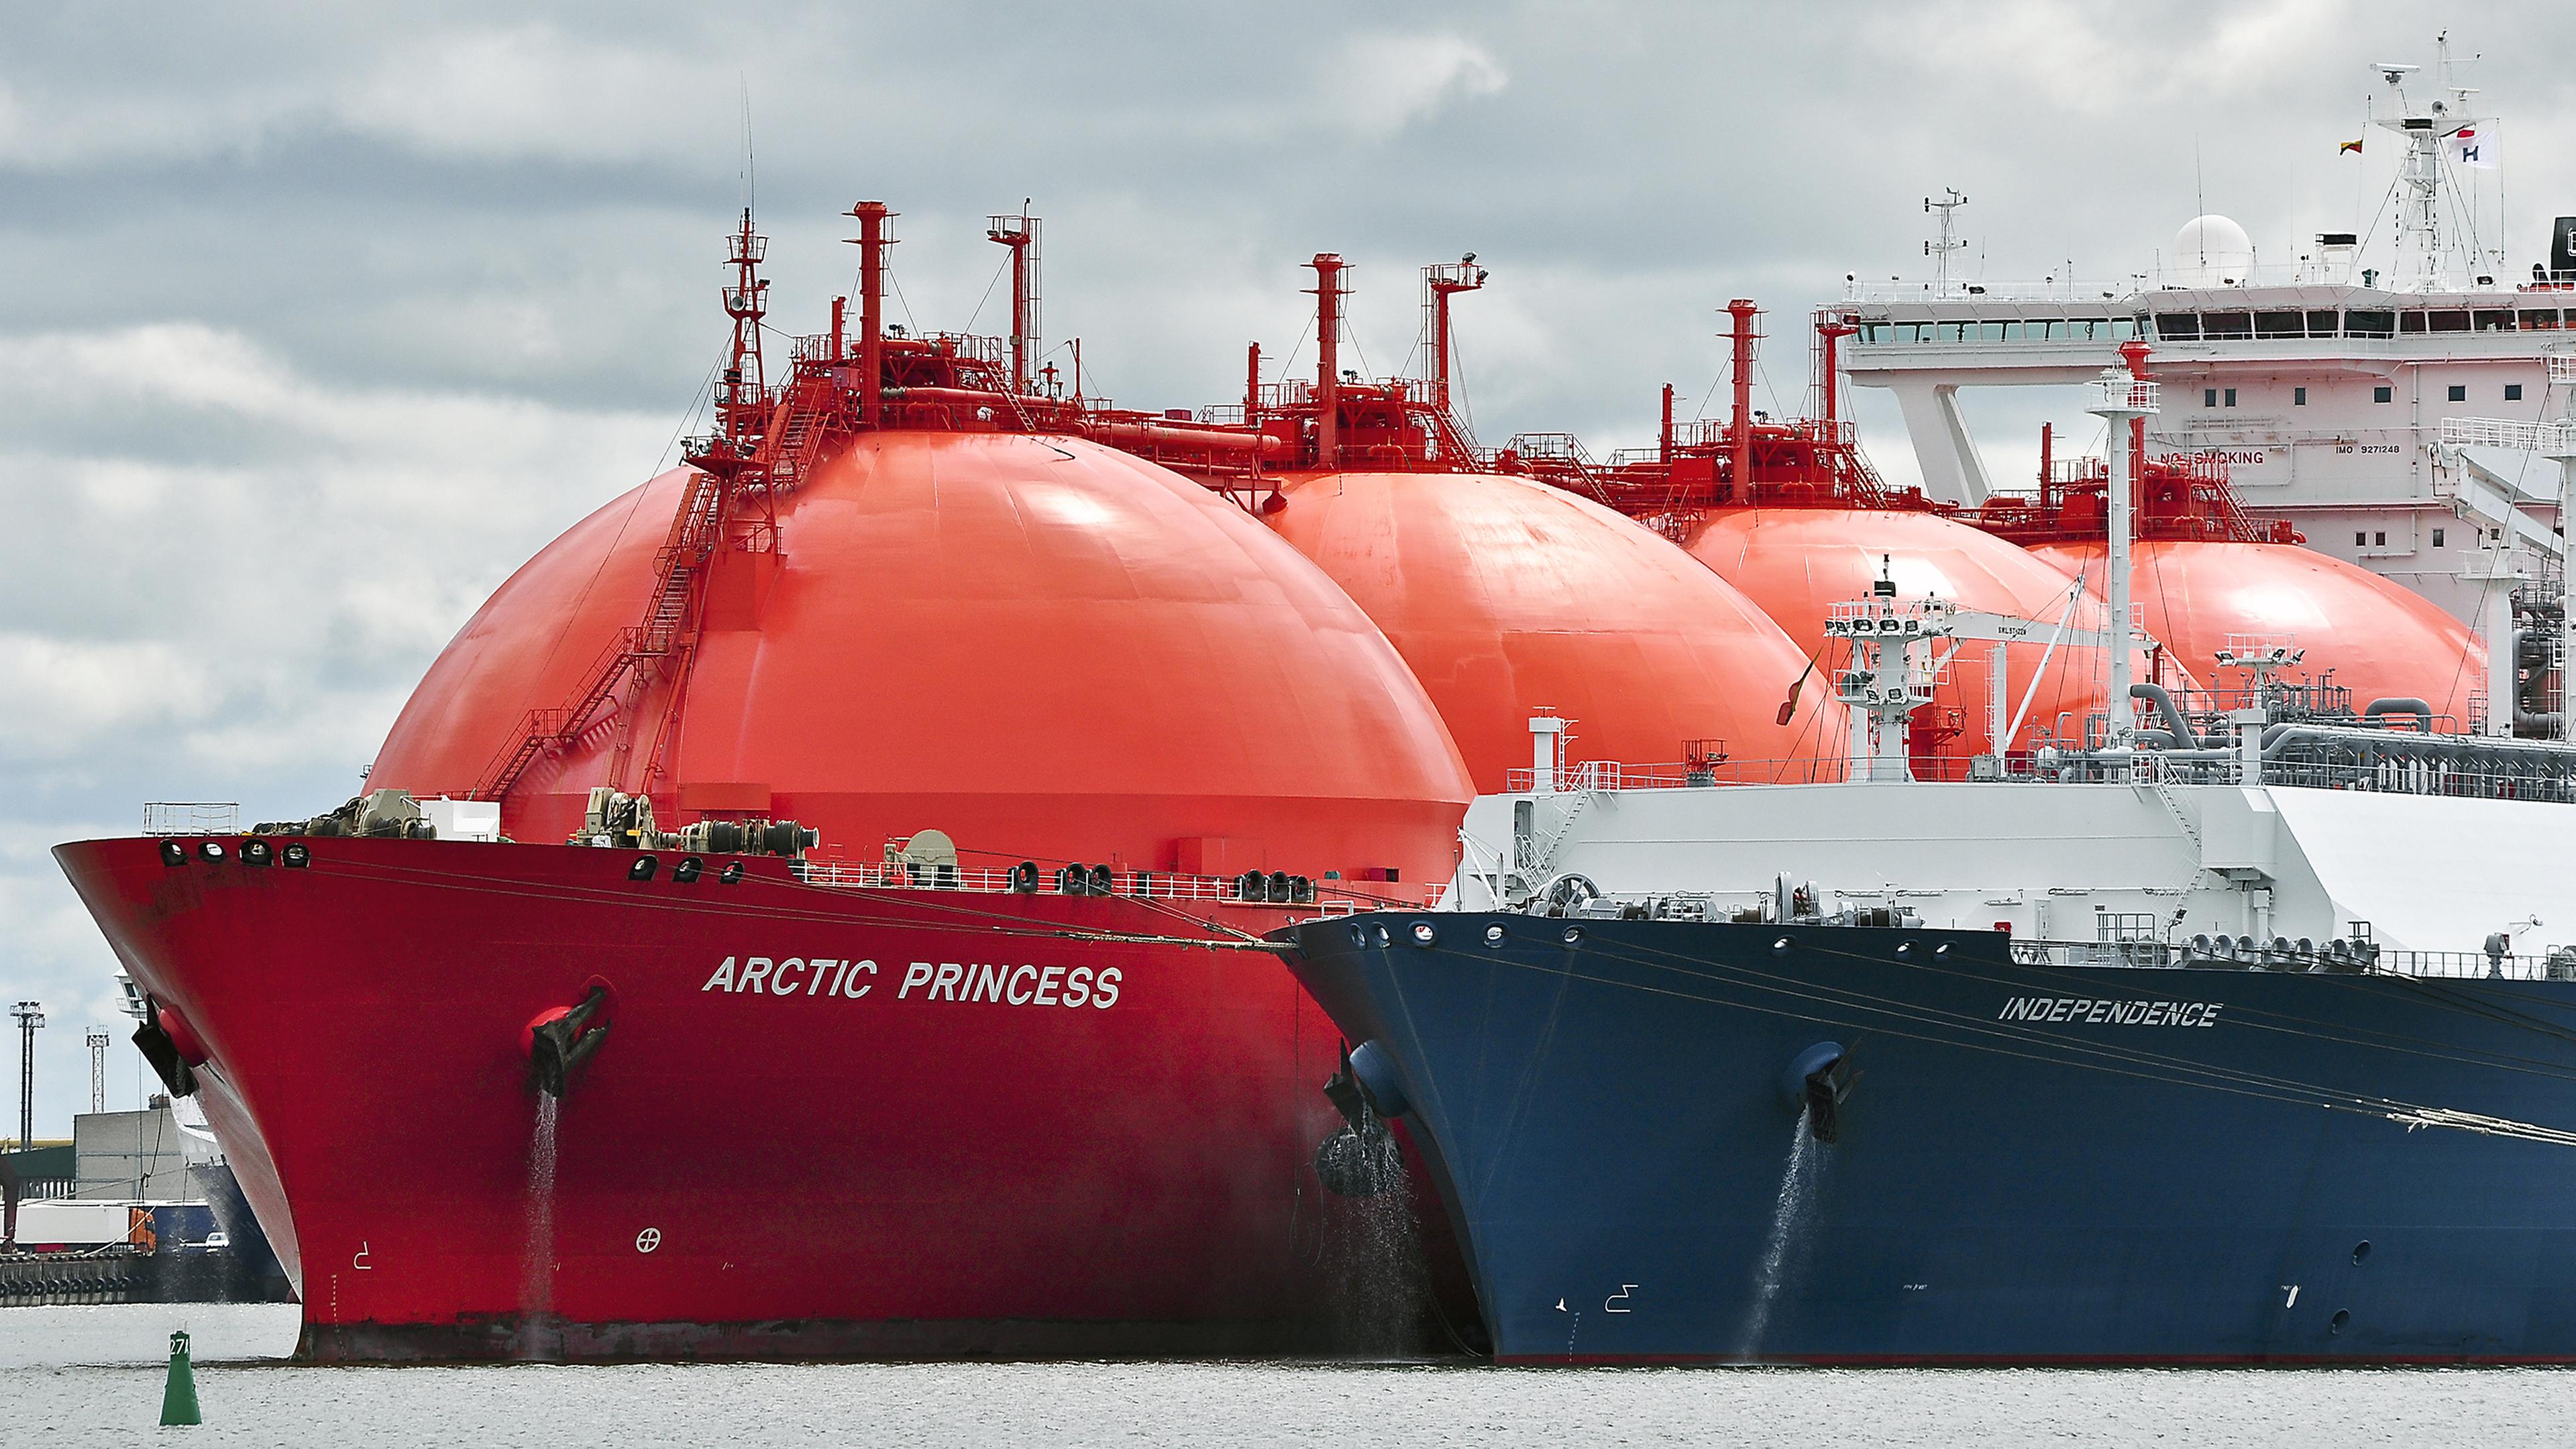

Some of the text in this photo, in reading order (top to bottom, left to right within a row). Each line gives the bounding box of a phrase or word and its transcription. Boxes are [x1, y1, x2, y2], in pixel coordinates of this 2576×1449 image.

[2463, 146, 2479, 162] H
[2361, 445, 2400, 453] 9271248
[2194, 452, 2263, 464] SMOKING
[702, 956, 1122, 1009] ARCTIC PRINCESS
[1998, 998, 2224, 1027] INDEPENDENCE
